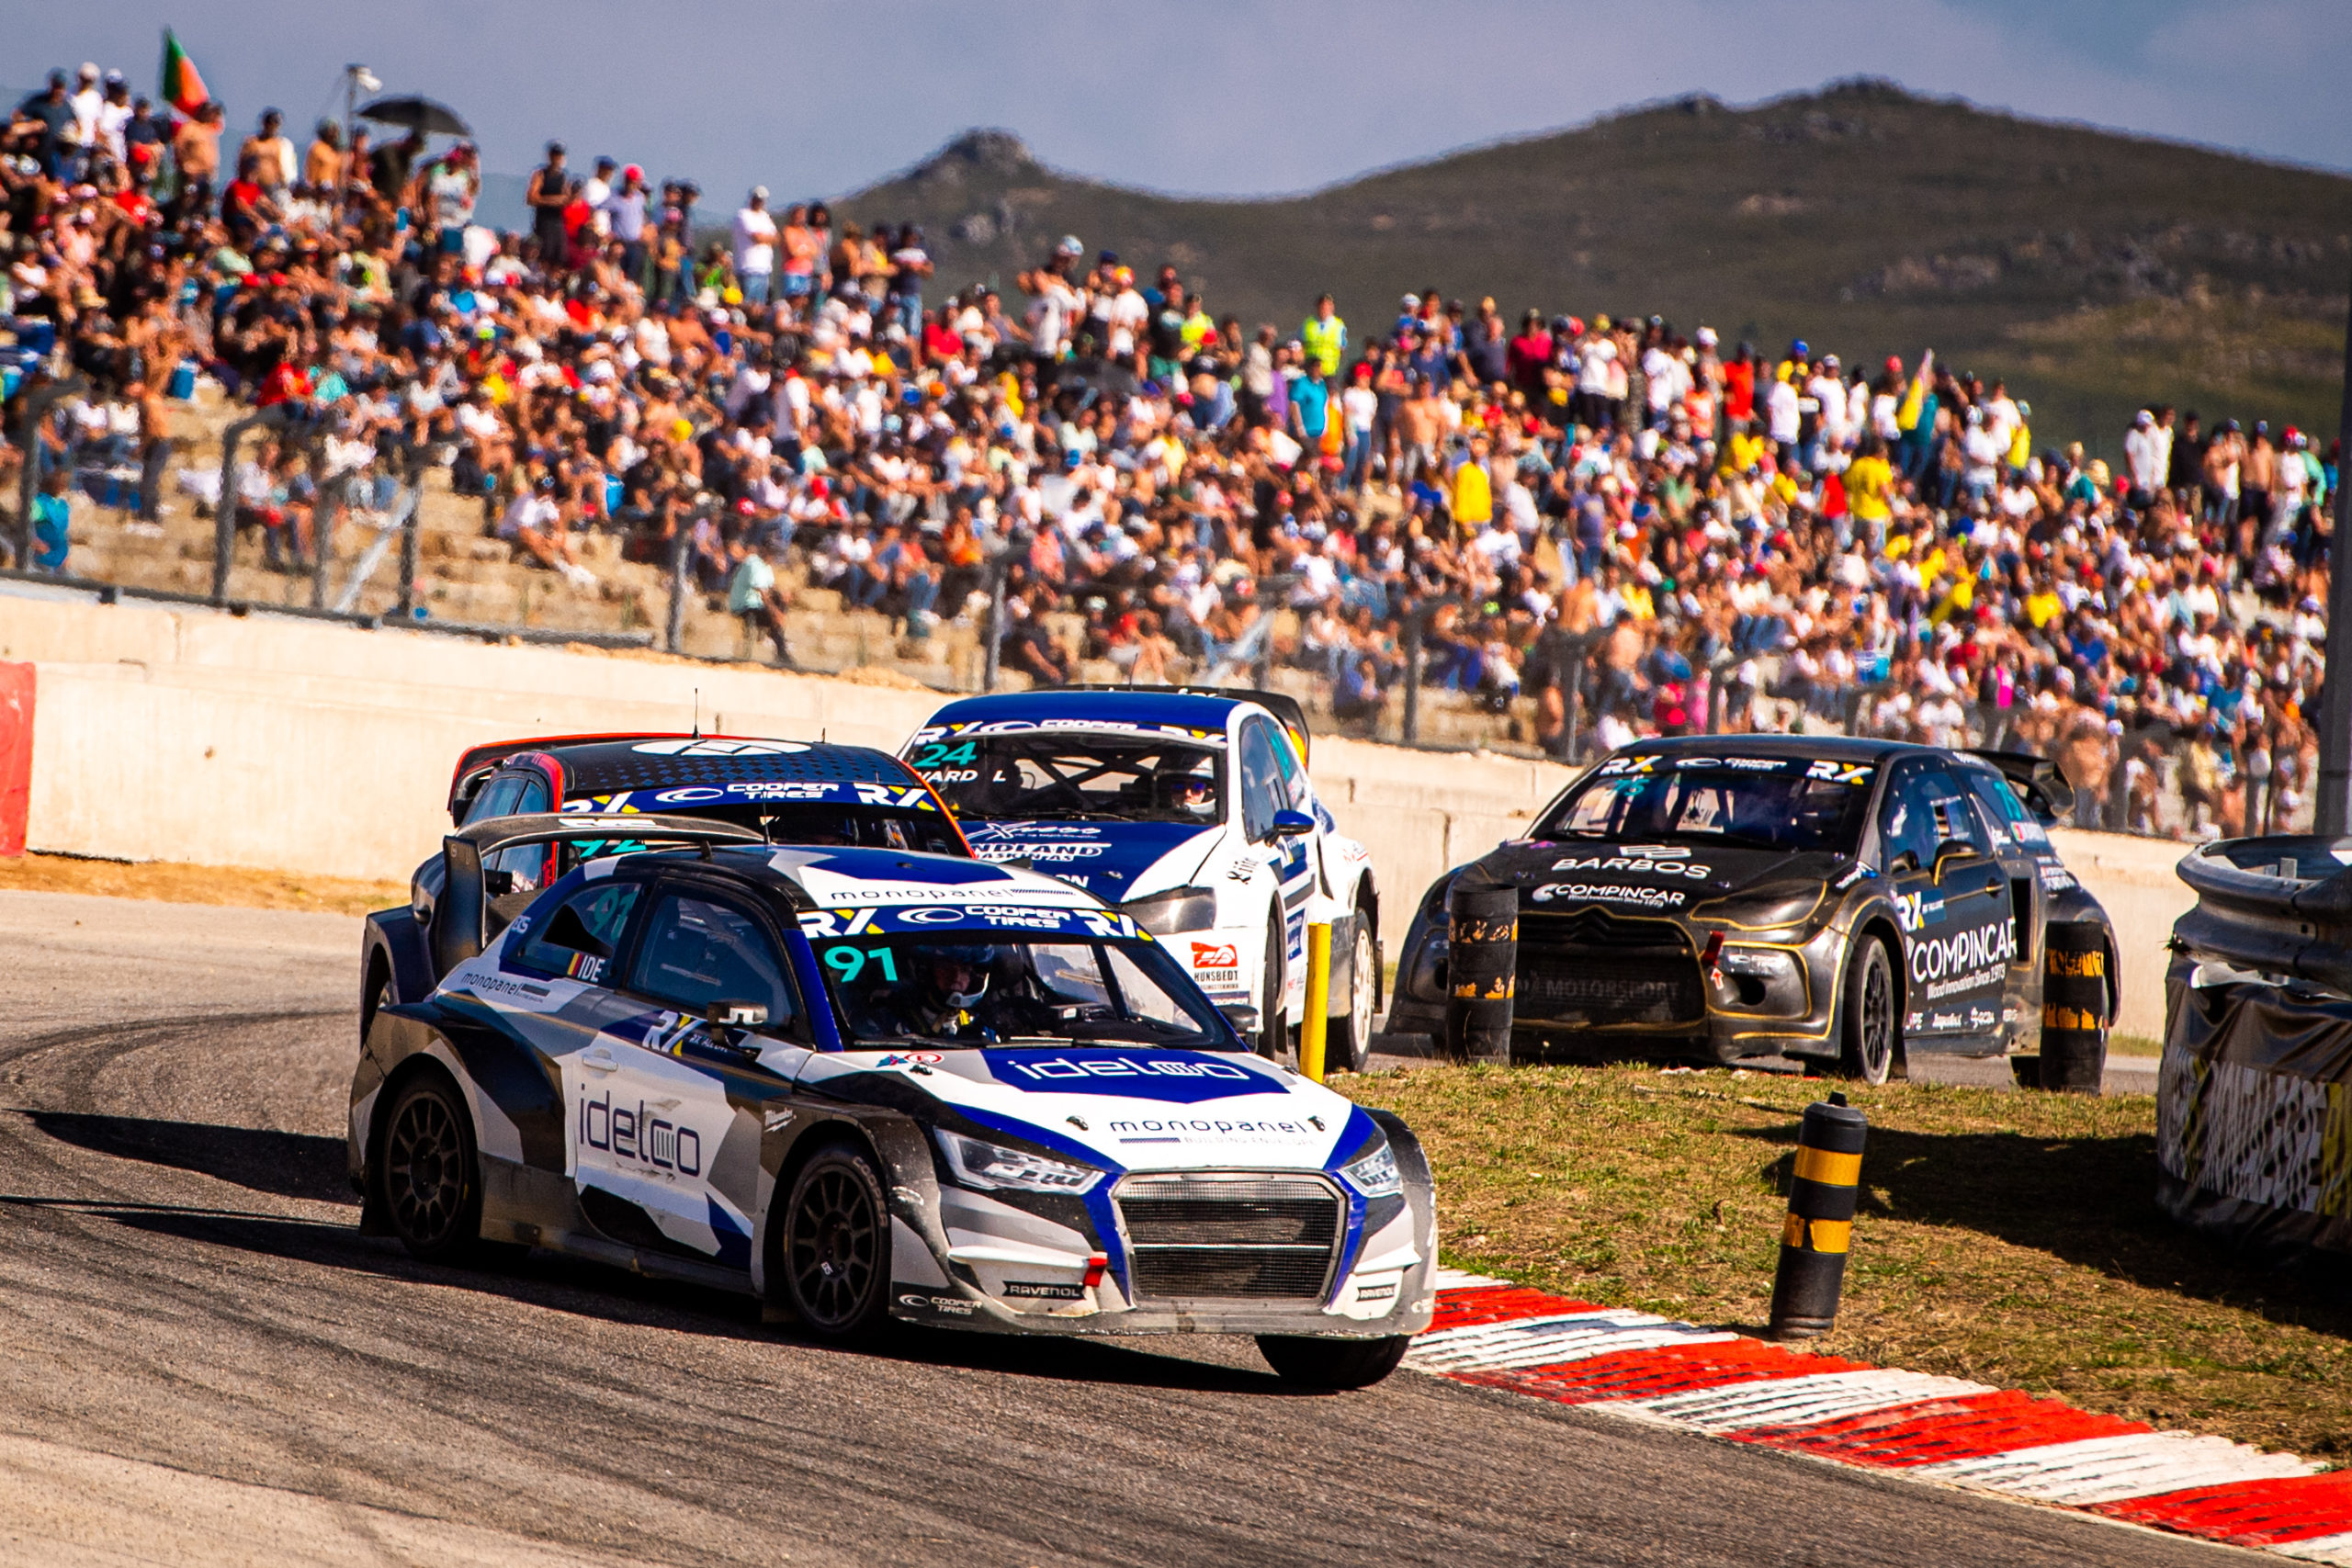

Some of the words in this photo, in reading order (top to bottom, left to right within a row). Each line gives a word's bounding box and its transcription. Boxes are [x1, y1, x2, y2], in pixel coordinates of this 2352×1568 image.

[1041, 719, 1137, 730] COOPER
[913, 741, 978, 767] 24
[1600, 755, 1663, 775] RX
[992, 770, 1007, 783] L
[1805, 760, 1873, 784] RX
[727, 783, 840, 792] COOPER
[744, 791, 824, 800] TIRES
[854, 783, 935, 811] RX
[1607, 778, 1650, 796] 75
[1551, 857, 1712, 879] BARBOS
[831, 888, 1013, 901] monopanel
[1555, 884, 1685, 907] COMPINCAR
[590, 886, 639, 942] 91
[965, 906, 1071, 920] COOPER
[985, 916, 1061, 929] TIRES
[1897, 891, 1925, 932] RX
[797, 908, 885, 939] RX
[1073, 909, 1153, 942] RX
[578, 954, 605, 983] IDE
[824, 946, 899, 983] 91
[462, 971, 523, 995] monopanel
[642, 1010, 706, 1056] RX
[580, 1083, 700, 1177] idelco
[1110, 1121, 1307, 1134] monopanel
[931, 1296, 983, 1309] COOPER
[1010, 1286, 1080, 1297] RAVENOL
[937, 1304, 973, 1315] TIRES
